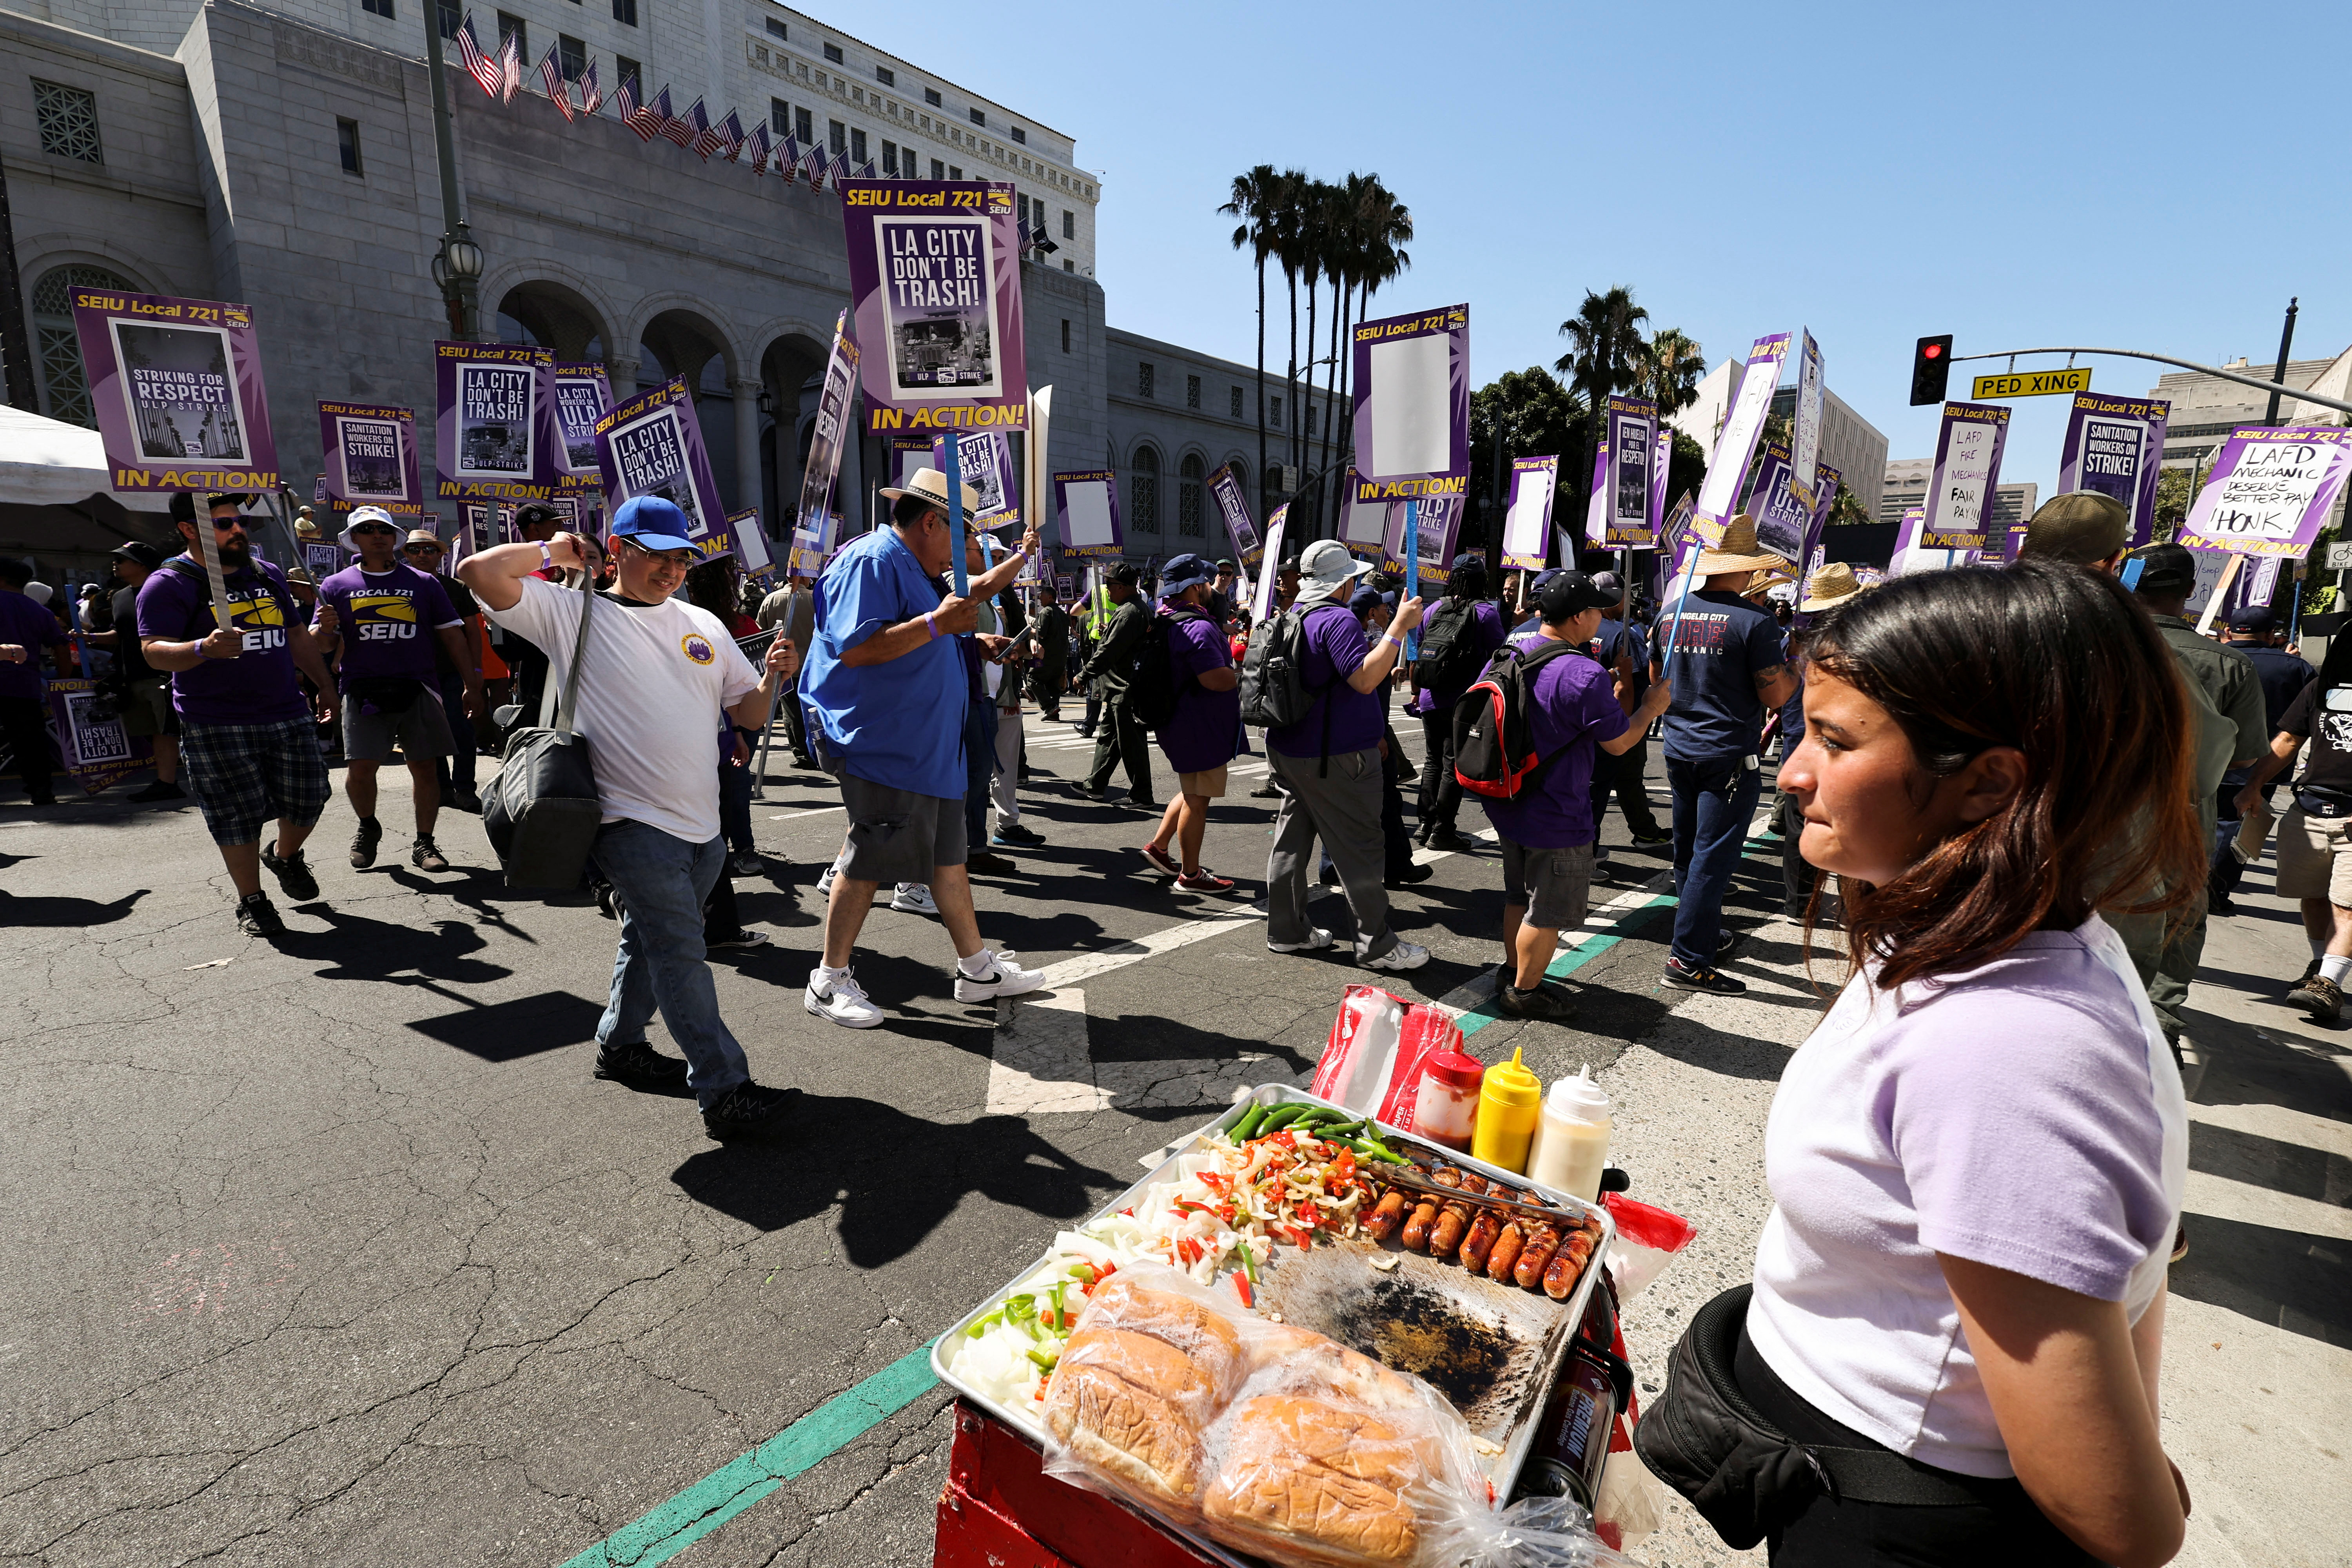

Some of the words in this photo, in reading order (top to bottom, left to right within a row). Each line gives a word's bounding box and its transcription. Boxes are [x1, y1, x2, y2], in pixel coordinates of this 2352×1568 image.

[847, 189, 891, 205] SEIU
[897, 191, 945, 206] Local
[951, 191, 982, 207] 721
[989, 206, 1011, 214] SEIU
[891, 229, 918, 256] LA
[926, 229, 976, 256] CITY
[894, 257, 947, 279] DON'T
[955, 257, 978, 279] BE
[895, 279, 979, 306] TRASH!
[78, 295, 124, 310] SEIU
[131, 301, 181, 316] Local
[188, 307, 218, 320] 721
[1356, 326, 1383, 341] SEIU
[1386, 320, 1419, 336] Local
[1423, 315, 1444, 330] 721
[1448, 322, 1465, 330] SEIU
[439, 347, 469, 358] SEIU
[473, 349, 505, 359] Local
[508, 351, 531, 361] 721
[134, 369, 195, 384] STRIKING
[199, 374, 224, 386] FOR
[468, 372, 485, 388] LA
[491, 372, 525, 390] CITY
[959, 371, 981, 379] STRIKE
[137, 382, 225, 403] RESPECT
[1981, 379, 2022, 395] PED
[2031, 374, 2080, 392] XING
[467, 388, 503, 403] DON'T
[508, 390, 524, 404] BE
[557, 388, 570, 399] LA
[572, 388, 591, 399] CITY
[141, 400, 168, 409] ULP
[178, 402, 228, 412] STRIKE
[467, 402, 523, 421] TRASH!
[595, 414, 615, 435] SEIU
[617, 403, 645, 421] Local
[647, 390, 666, 408] 721
[562, 405, 597, 426] ULP
[871, 408, 903, 429] IN
[909, 404, 1025, 428] ACTION!
[346, 424, 392, 435] SANITATION
[619, 434, 637, 457] LA
[639, 419, 670, 448] CITY
[1622, 426, 1631, 439] ¡EN
[1631, 428, 1645, 442] HUELGA
[1956, 431, 1982, 444] LAFD
[2091, 425, 2138, 442] SANITATION
[2233, 430, 2269, 439] SEIU
[2270, 431, 2311, 440] Local
[2311, 432, 2341, 440] 721
[347, 433, 382, 444] WORKERS
[1636, 442, 1640, 450] EL
[348, 443, 395, 458] STRIKE!
[623, 445, 656, 472] DON'T
[661, 438, 676, 456] BE
[1960, 449, 1978, 461] FIRE
[2089, 439, 2125, 454] WORKERS
[2125, 443, 2136, 456] ON
[2246, 445, 2316, 465] LAFD
[496, 461, 524, 469] STRIKE
[1622, 449, 1644, 465] RESPETO!
[2086, 453, 2134, 476] STRIKE!
[117, 470, 151, 486] IN
[158, 471, 277, 488] ACTION!
[627, 454, 681, 491] TRASH!
[1951, 469, 1987, 481] MECHANICS
[2232, 467, 2318, 479] MECHANIC
[439, 482, 463, 495] IN
[465, 482, 551, 500] ACTION!
[1359, 483, 1380, 499] IN
[1383, 476, 1467, 497] ACTION!
[2227, 479, 2290, 492] DESERVE
[1220, 490, 1225, 499] LA
[1951, 487, 1975, 503] FAIR
[2223, 492, 2280, 504] BETTER
[2283, 492, 2312, 510] PAY
[1226, 499, 1240, 519] ULP
[1769, 506, 1802, 528] STRIKE
[1954, 505, 1980, 525] PAY!!!
[1232, 514, 1245, 528] STRIKE
[1078, 546, 1123, 556] ACTION!
[2178, 535, 2207, 548] IN
[2205, 538, 2309, 555] ACTION!
[1502, 555, 1513, 565] IN
[1513, 557, 1546, 568] ACTION!
[350, 589, 390, 598] LOCAL
[394, 589, 414, 597] 721
[1662, 613, 1675, 621] LOS
[1675, 612, 1709, 621] NGELES
[1710, 613, 1730, 622] CITY
[359, 624, 416, 641] SEIU
[1661, 619, 1728, 648] FIRE
[1662, 646, 1723, 655] MCHANIC
[80, 726, 120, 739] TRASH!
[97, 736, 121, 746] DON'T
[82, 739, 93, 748] BE
[85, 746, 108, 758] CITY
[112, 744, 123, 754] LA
[1431, 1025, 1441, 1042] Re-order
[1393, 1106, 1405, 1128] PAPER
[1569, 1388, 1580, 1408] Butane
[1565, 1407, 1574, 1419] Gas
[1557, 1419, 1571, 1446] Cartridge
[1567, 1392, 1595, 1461] PREMIUM
